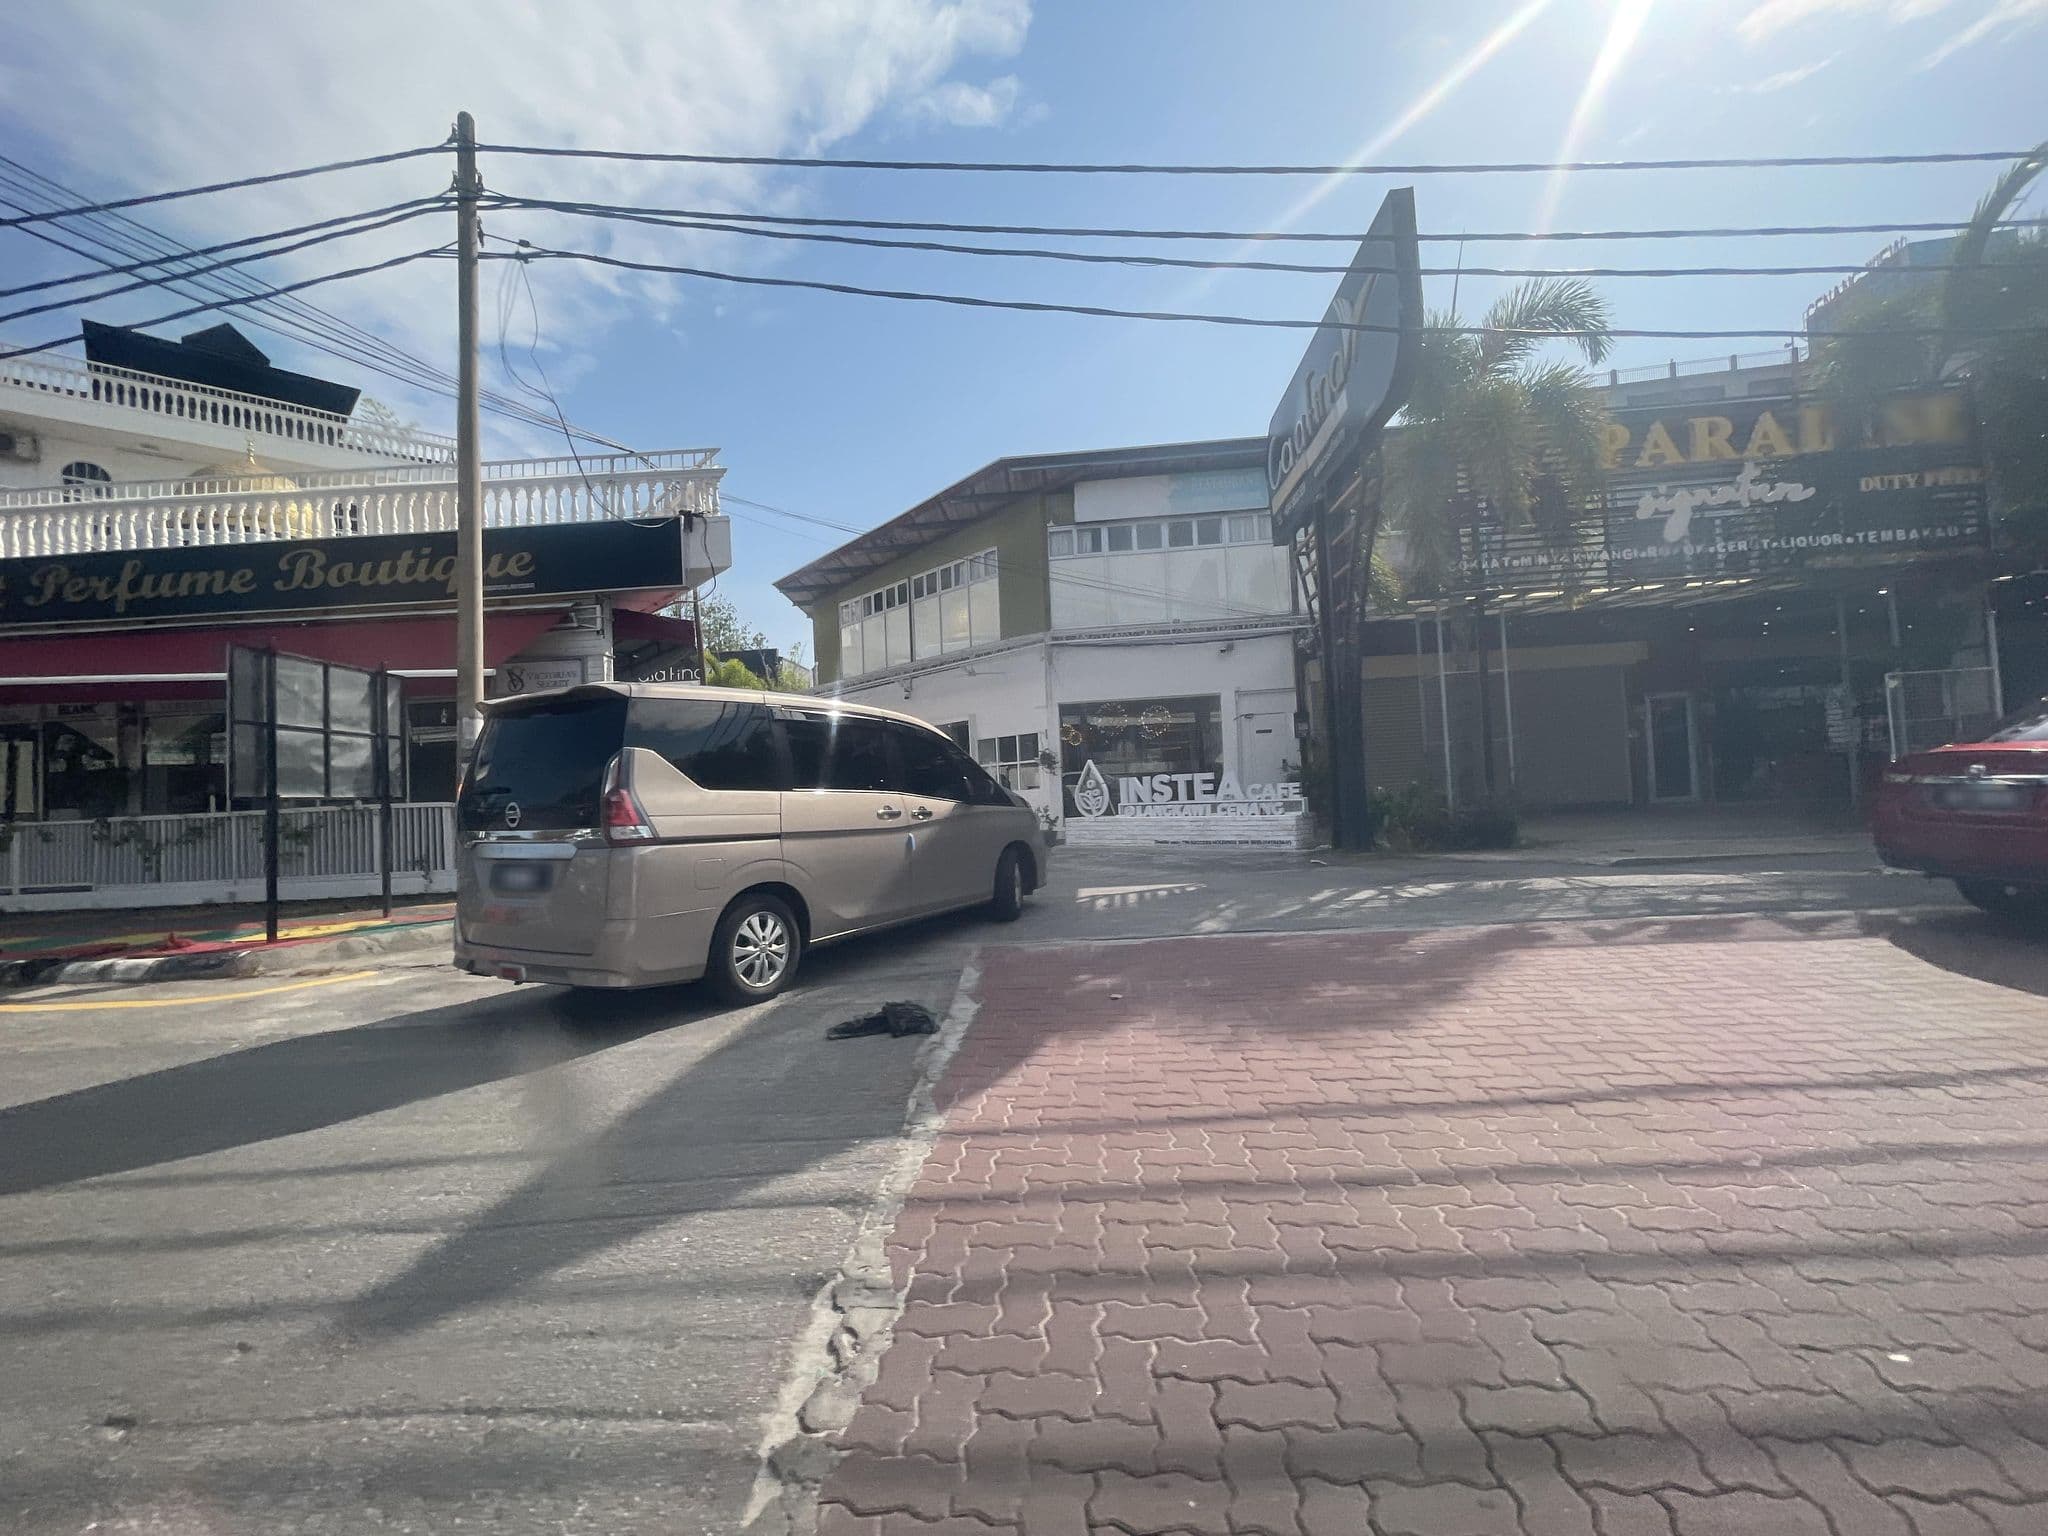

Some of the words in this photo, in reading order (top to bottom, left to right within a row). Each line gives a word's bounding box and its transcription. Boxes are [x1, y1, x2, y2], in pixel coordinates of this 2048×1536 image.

[1860, 473, 1919, 492] DUTY
[1780, 532, 1847, 549] LIQUOR
[23, 559, 257, 613] Perfume
[1119, 769, 1247, 804] INSTEA
[1247, 782, 1302, 801] CAFE
